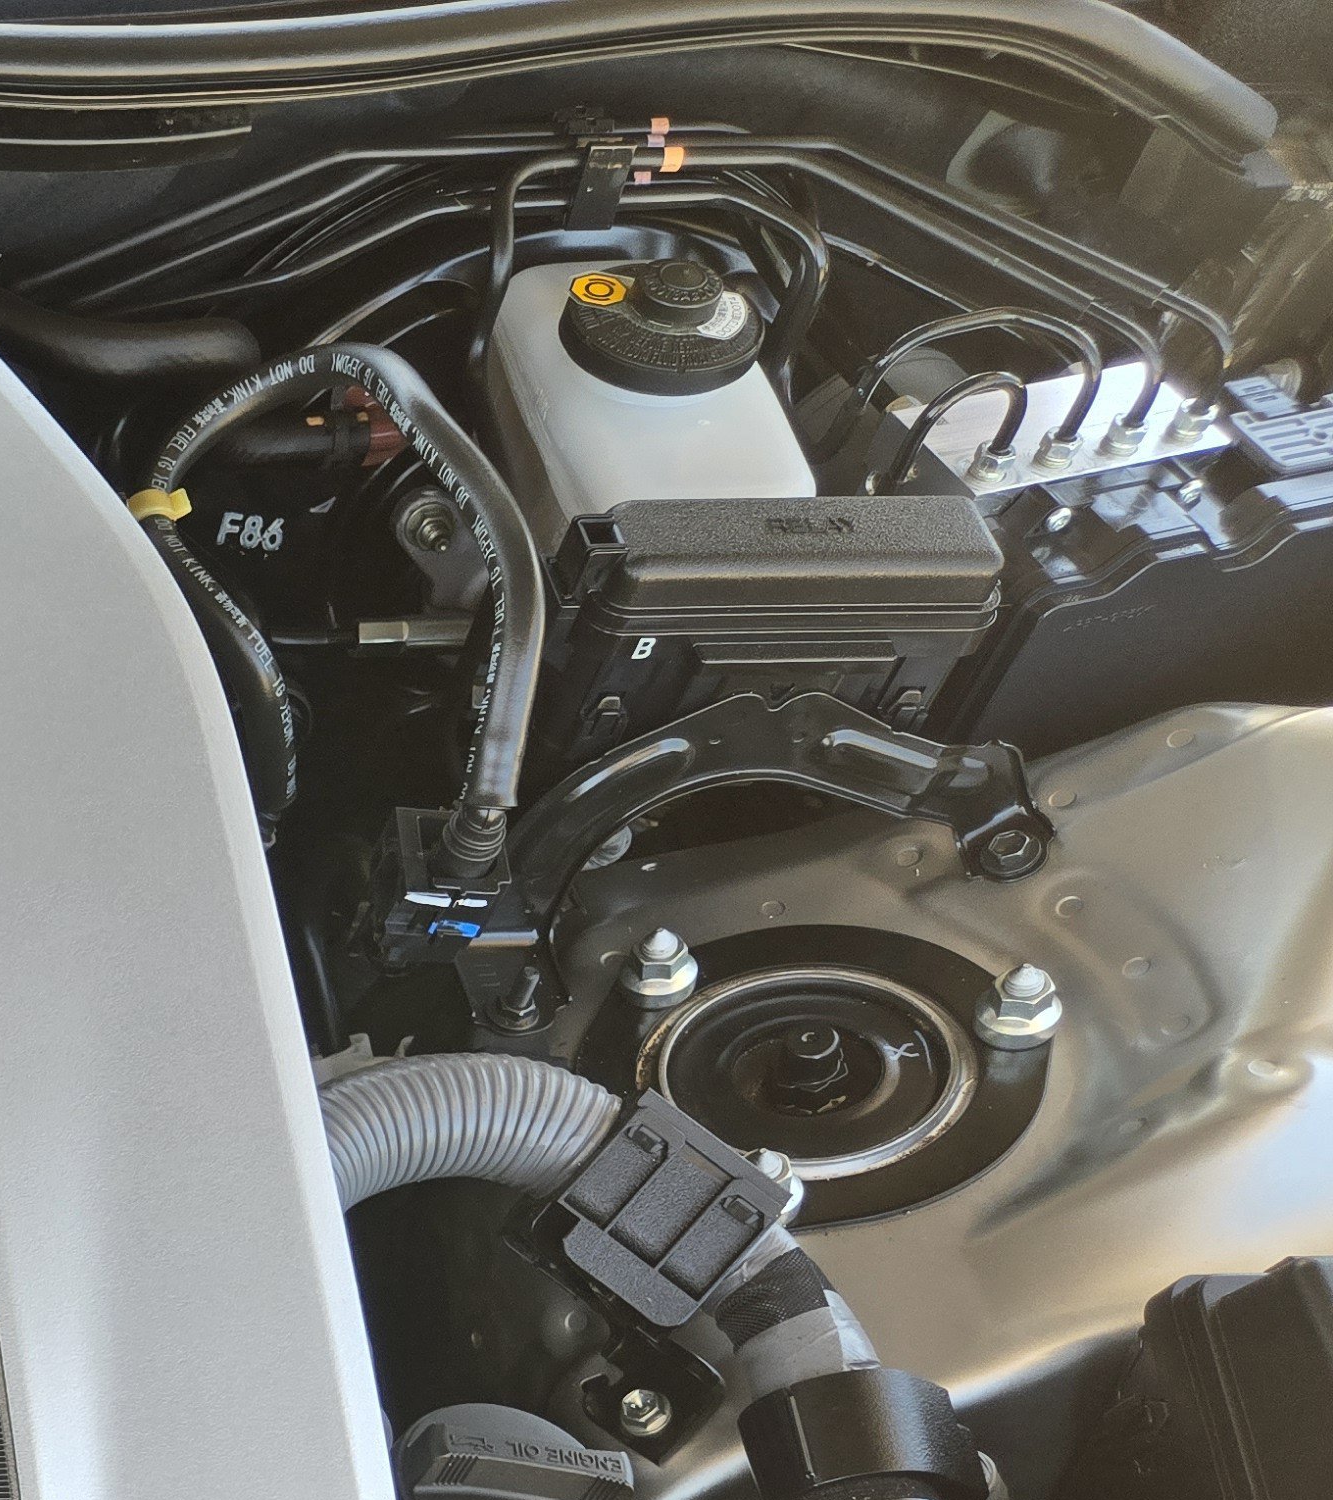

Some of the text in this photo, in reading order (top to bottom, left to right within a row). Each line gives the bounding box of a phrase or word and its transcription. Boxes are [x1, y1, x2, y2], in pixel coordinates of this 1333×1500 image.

[269, 361, 294, 386] NOT
[299, 354, 315, 374] DO
[376, 378, 393, 408] FUEL
[165, 424, 197, 452] FUEL
[437, 463, 459, 492] NOT
[455, 486, 470, 510] DO
[155, 518, 173, 531] DO
[217, 512, 285, 551] F86
[162, 535, 188, 554] NOT
[247, 629, 276, 673] FUEL
[631, 637, 656, 660] B
[506, 1440, 623, 1473] ENGINE OIL
